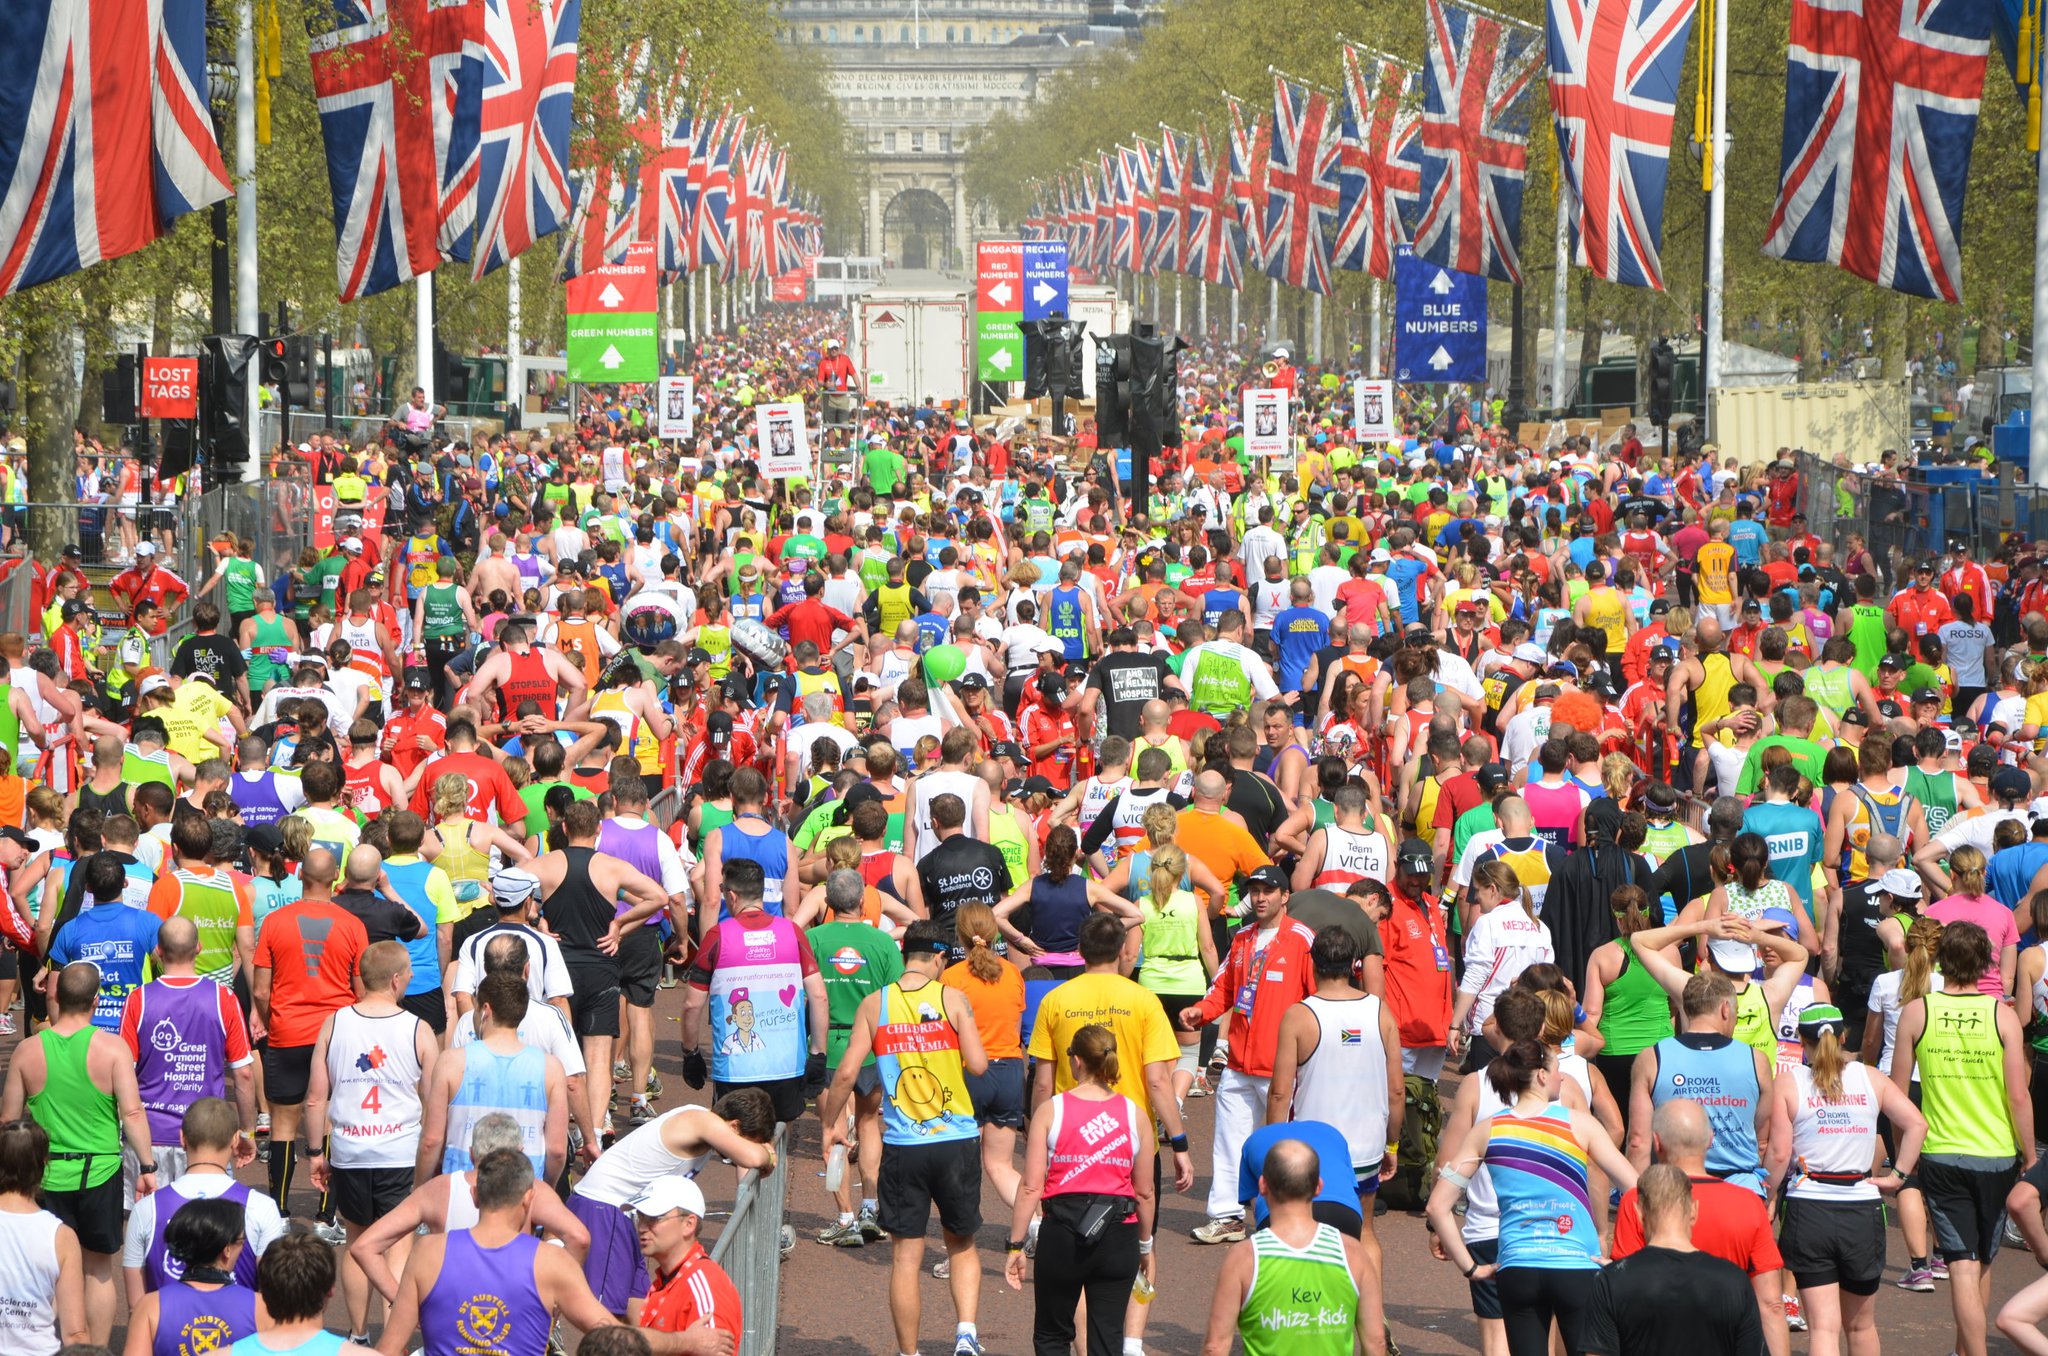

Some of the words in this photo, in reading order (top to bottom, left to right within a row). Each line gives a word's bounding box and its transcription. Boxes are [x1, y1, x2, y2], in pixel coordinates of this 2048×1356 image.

[980, 245, 1024, 254] BAGGAGE
[1026, 245, 1066, 254] RECLAIM
[598, 265, 646, 275] NUMBERS
[1035, 262, 1056, 270] BLUE
[980, 272, 1019, 280] NUMBERS
[1026, 271, 1066, 279] NUMBERS
[1422, 304, 1461, 316] BLUE
[571, 328, 604, 338] GREEN
[606, 327, 654, 337] NUMBERS
[1406, 320, 1478, 334] NUMBERS
[981, 332, 1019, 340] NUMBERS
[148, 367, 191, 382] LOST
[148, 384, 190, 399] TAGS
[1854, 607, 1881, 618] WILL
[1054, 628, 1079, 638] BOB
[1950, 629, 1984, 639] ROSSI
[561, 638, 582, 651] MS
[194, 649, 206, 658] BE
[206, 648, 214, 656] A
[196, 664, 216, 672] SAVE
[1126, 670, 1143, 678] AND
[510, 680, 551, 690] STOPSLEY
[1114, 679, 1124, 689] ST
[1126, 678, 1156, 688] HELENA
[512, 692, 551, 703] STRIDERS
[1120, 688, 1153, 698] HOSPICE
[820, 812, 830, 822] St
[1348, 842, 1372, 854] Team
[1768, 838, 1803, 855] RNIB
[938, 877, 948, 889] St
[949, 873, 972, 886] John
[940, 882, 972, 894] Ambulance
[1064, 1008, 1094, 1020] Caring
[1096, 1007, 1106, 1016] for
[1108, 1005, 1131, 1016] those
[760, 1011, 796, 1030] nurses
[1094, 1018, 1113, 1028] need
[886, 1021, 944, 1035] CHILDREN
[178, 1042, 207, 1053] Great
[164, 1052, 206, 1063] Ormond
[175, 1062, 206, 1072] Street
[164, 1072, 205, 1082] Hospital
[1687, 1076, 1720, 1086] ROYAL
[174, 1082, 204, 1094] Charity
[1673, 1086, 1686, 1096] AIR
[1688, 1086, 1720, 1094] FORCES
[361, 1085, 382, 1114] 4
[1808, 1094, 1868, 1108] KATHERINE
[342, 1123, 402, 1136] HANNAH
[1080, 1110, 1112, 1138] SAVE
[1084, 1117, 1119, 1146] LIVES
[1818, 1126, 1868, 1134] Association
[1550, 1198, 1576, 1212] Trust
[1559, 1216, 1572, 1226] 25
[1292, 1286, 1322, 1304] Kev
[473, 1294, 510, 1317] AUSTELL
[5, 1308, 32, 1318] Centre
[194, 1316, 232, 1338] AUSTELL
[456, 1320, 492, 1347] RUNNING
[492, 1322, 511, 1344] CLUB
